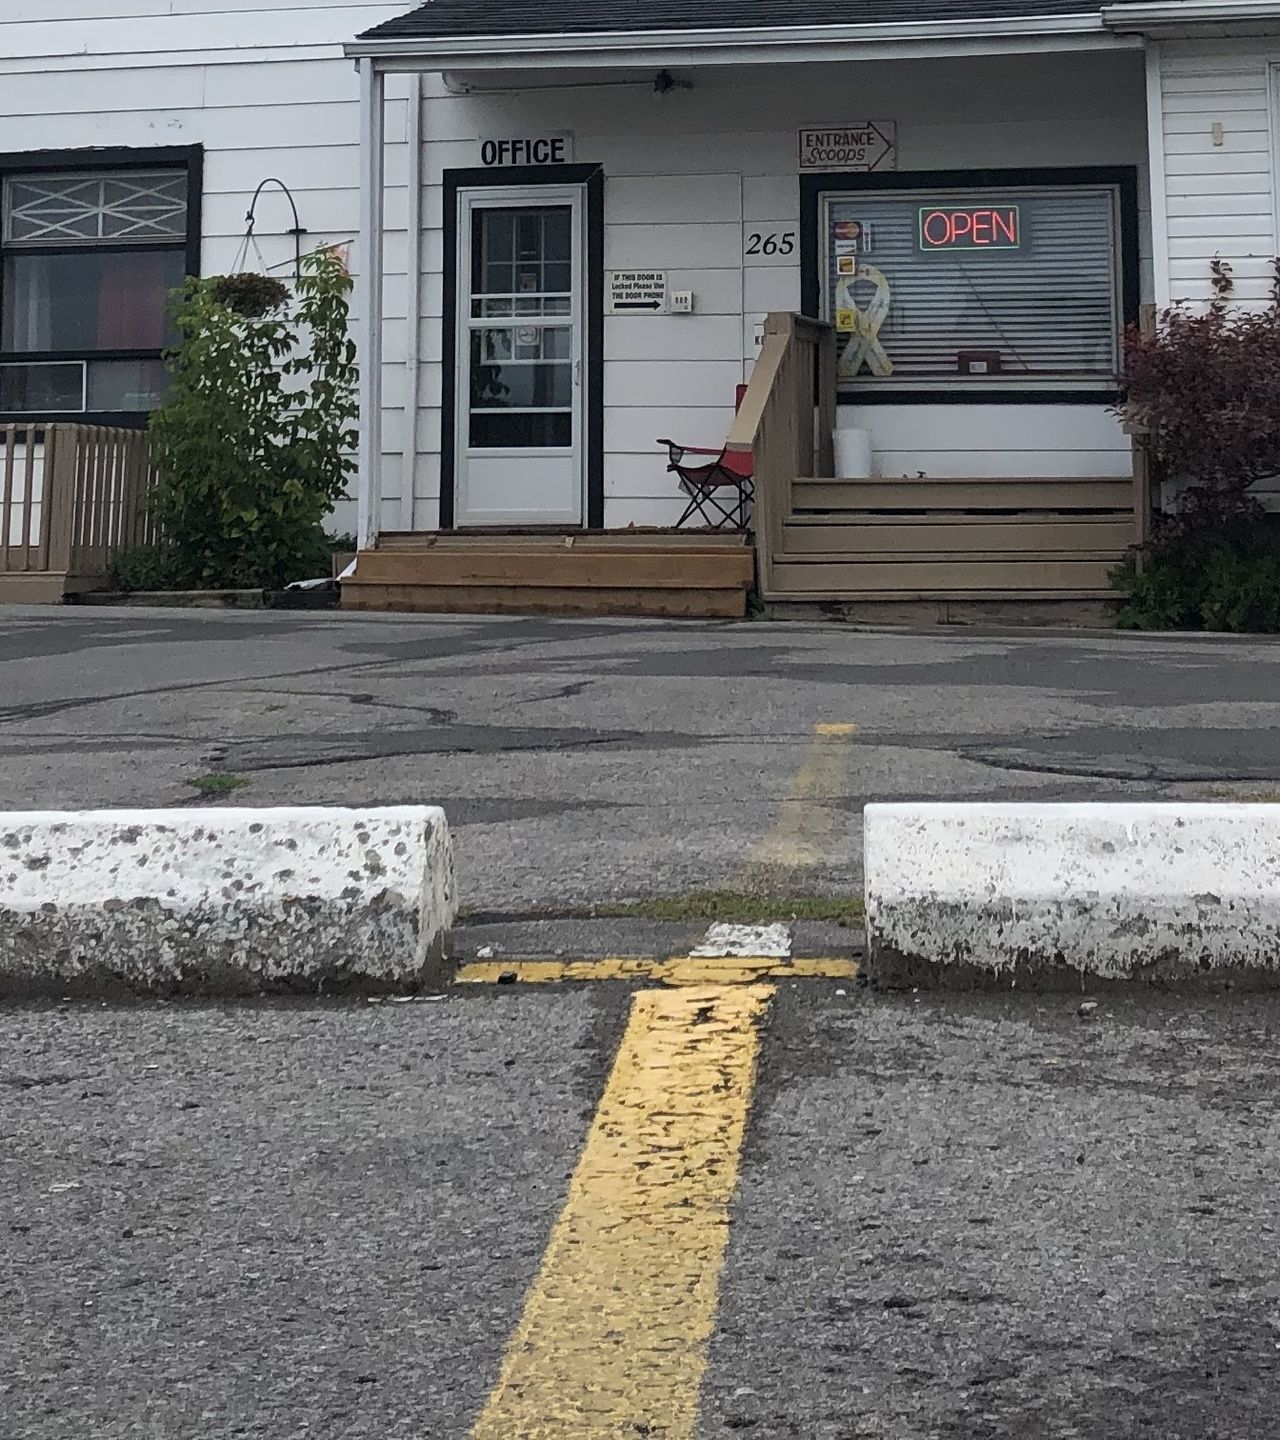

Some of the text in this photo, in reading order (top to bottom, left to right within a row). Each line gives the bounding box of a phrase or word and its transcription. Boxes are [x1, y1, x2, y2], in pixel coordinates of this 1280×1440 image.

[481, 138, 564, 165] OFFICE
[806, 132, 875, 147] ENTRANCE
[924, 211, 1015, 245] OPEN
[745, 232, 795, 255] 265
